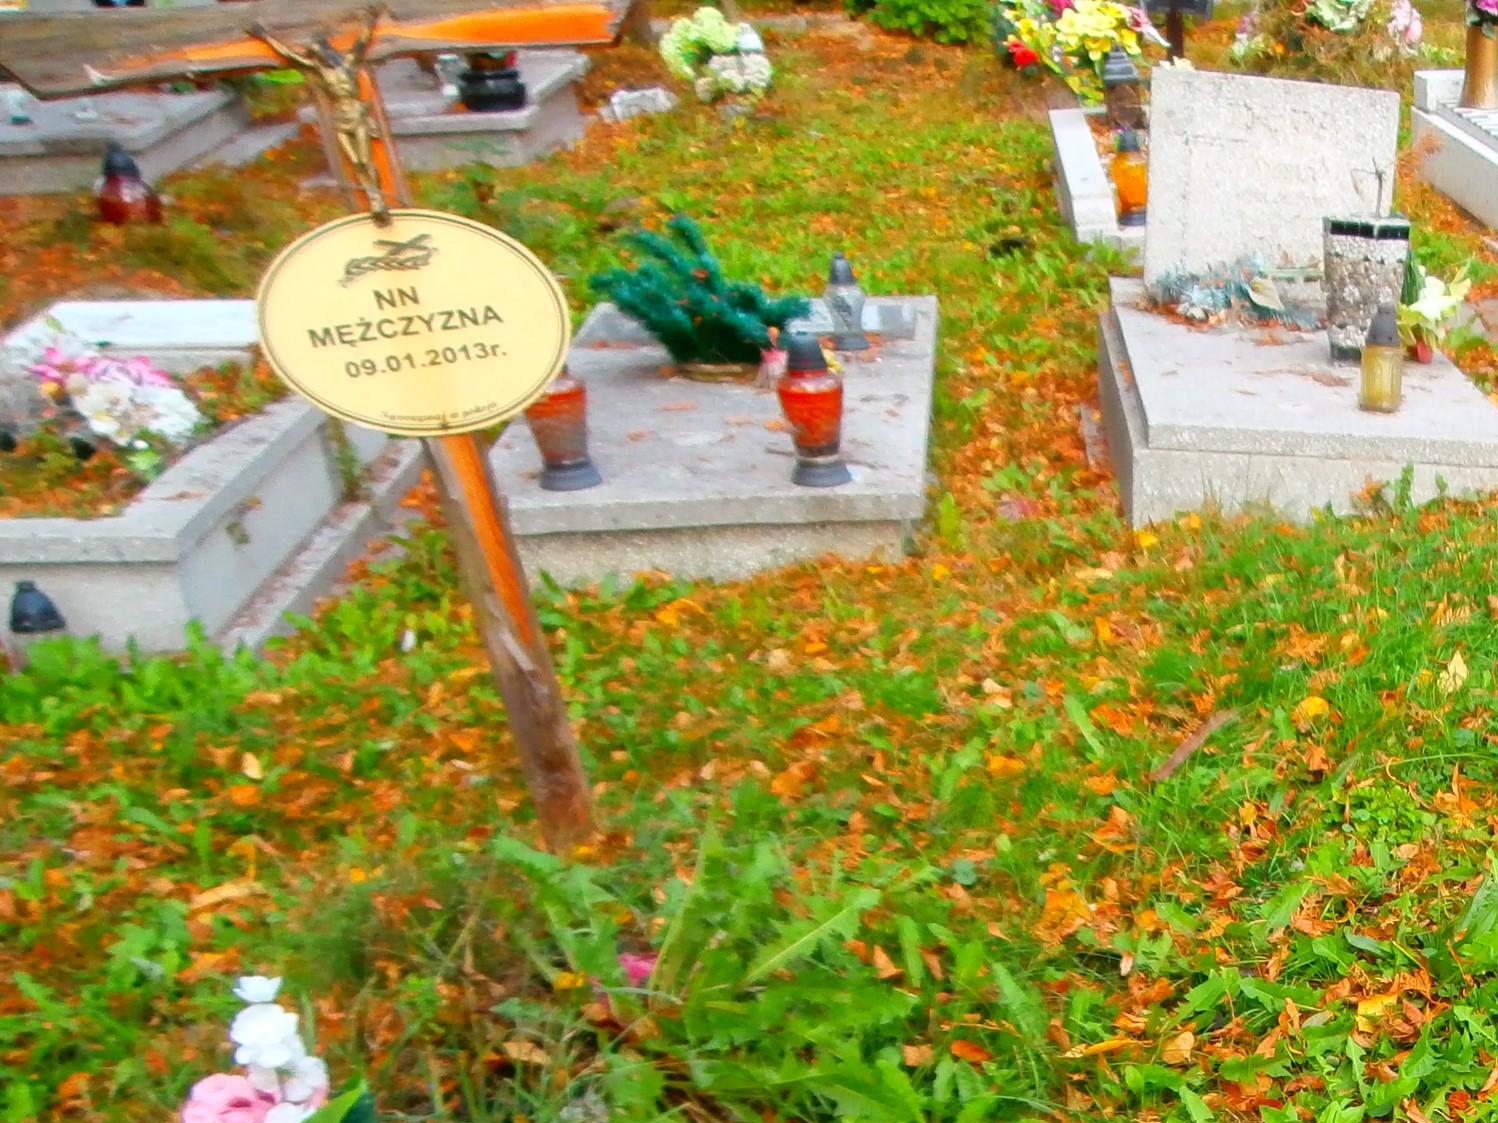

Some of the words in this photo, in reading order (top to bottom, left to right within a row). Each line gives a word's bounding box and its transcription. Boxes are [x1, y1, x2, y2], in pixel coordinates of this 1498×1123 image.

[372, 286, 421, 311] NN
[307, 305, 505, 349] MĘŻCZYZNA
[344, 342, 508, 378] 09.01.2013r.
